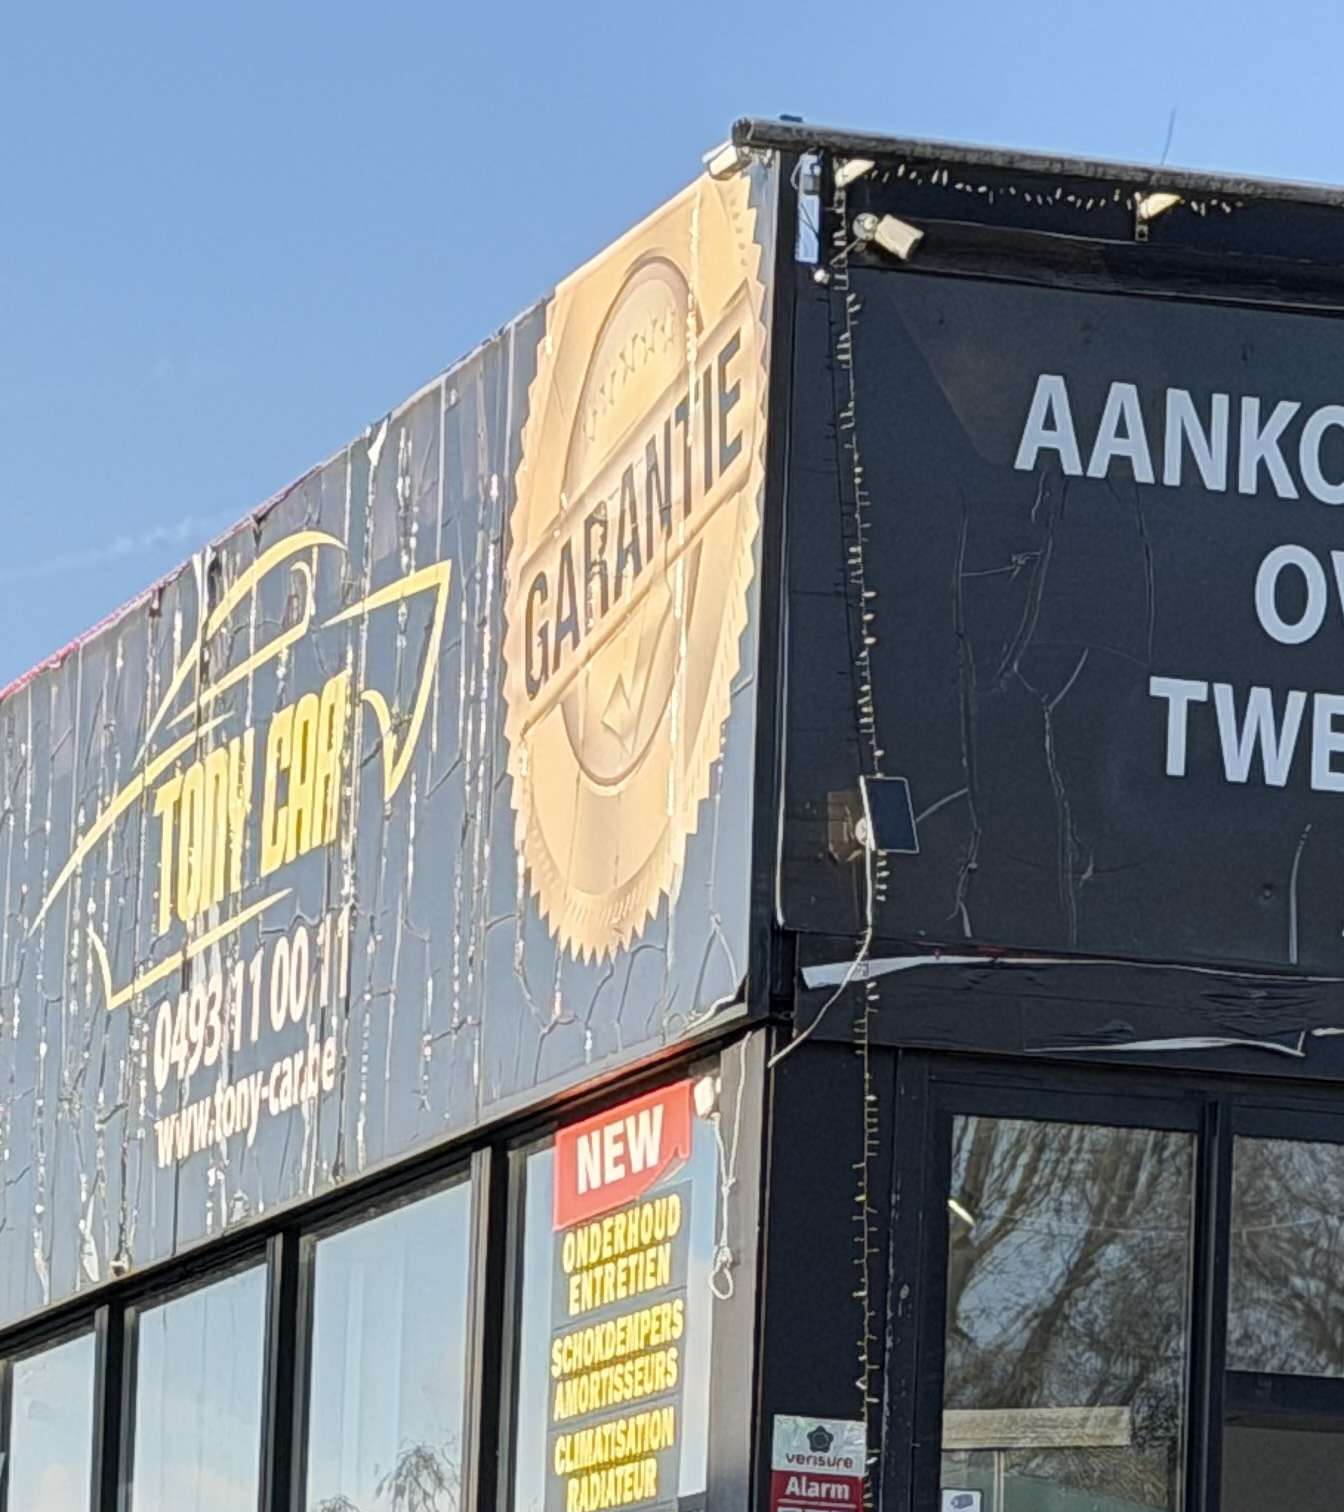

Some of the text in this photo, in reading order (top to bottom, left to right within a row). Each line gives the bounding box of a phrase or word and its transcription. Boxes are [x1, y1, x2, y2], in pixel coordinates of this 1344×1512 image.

[523, 328, 745, 702] GARANTIE
[154, 667, 350, 936] TONY CAR
[153, 973, 223, 1092] 0493
[229, 948, 264, 1053] 11
[269, 925, 309, 1033] 00
[154, 1025, 337, 1169] www.tony-car.be
[576, 1103, 665, 1195] NEW
[562, 1193, 682, 1273] ONDERHOUD
[569, 1242, 671, 1315] ENTRETIEN
[551, 1298, 684, 1378] SCHOKDEMPERS
[553, 1346, 678, 1421] AMORTISSEURS
[554, 1406, 675, 1475] CLIMATISATION
[785, 1453, 854, 1470] verisure
[785, 1476, 850, 1501] Alarm
